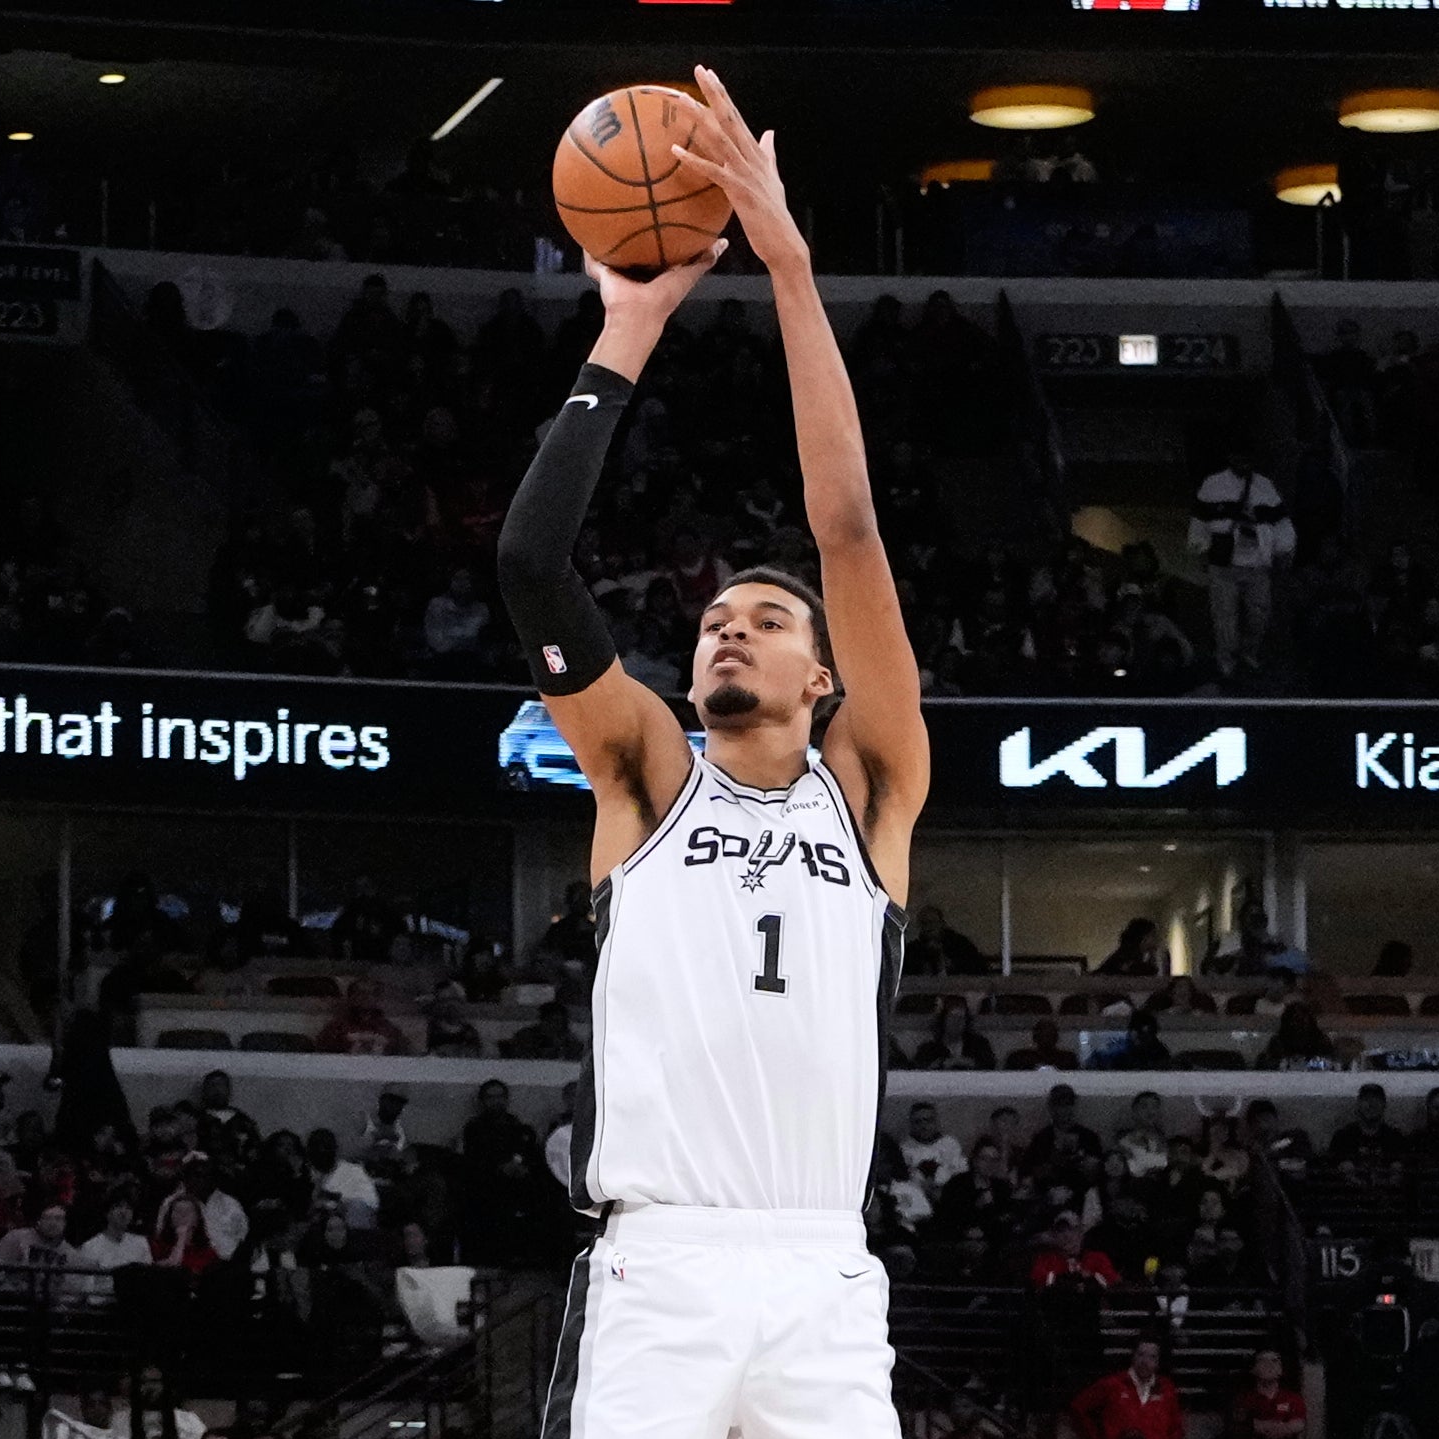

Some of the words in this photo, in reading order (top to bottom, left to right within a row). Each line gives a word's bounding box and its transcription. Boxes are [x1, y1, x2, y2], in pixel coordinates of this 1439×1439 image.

[141, 702, 390, 781] inspires
[751, 912, 790, 997] 1
[1321, 1246, 1360, 1277] 115
